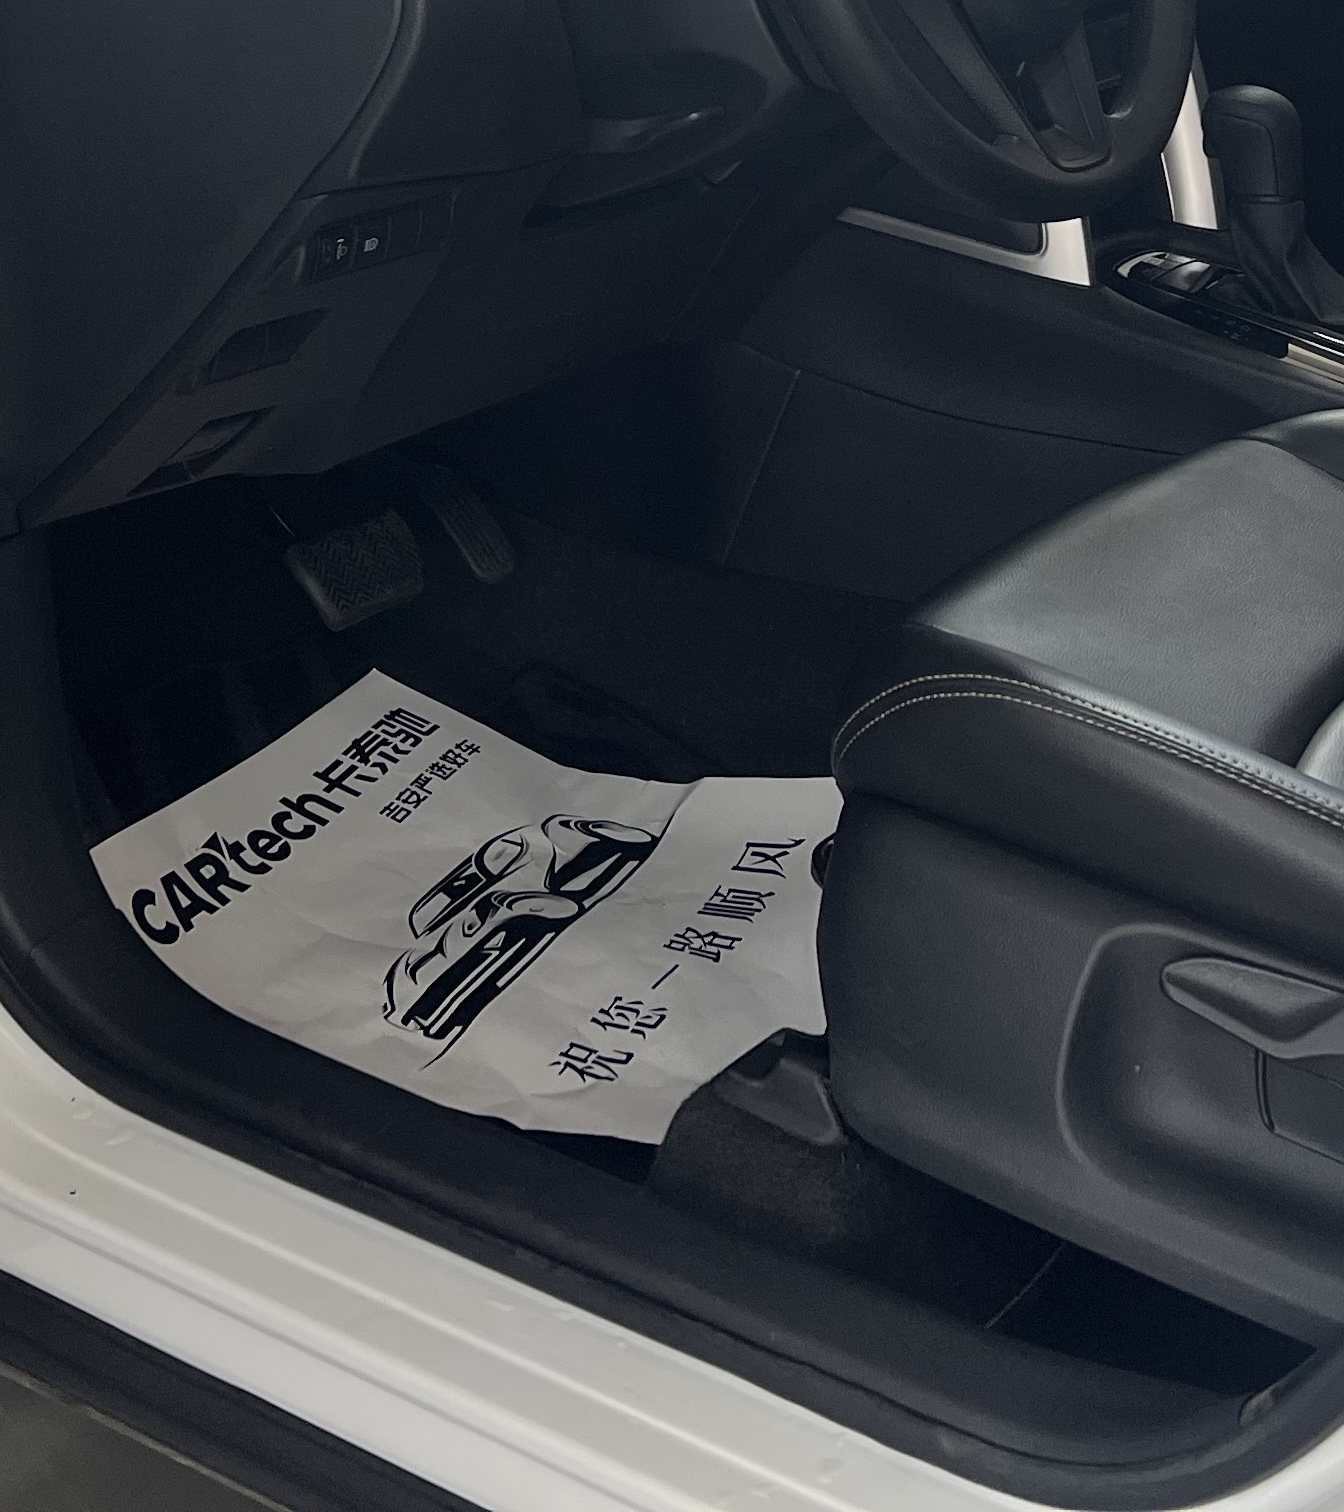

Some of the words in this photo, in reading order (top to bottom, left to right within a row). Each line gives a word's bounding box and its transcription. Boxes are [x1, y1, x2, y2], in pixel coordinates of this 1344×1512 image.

[379, 739, 482, 824] 吉安严选好车
[548, 838, 806, 1083] 祝您一路顺风
